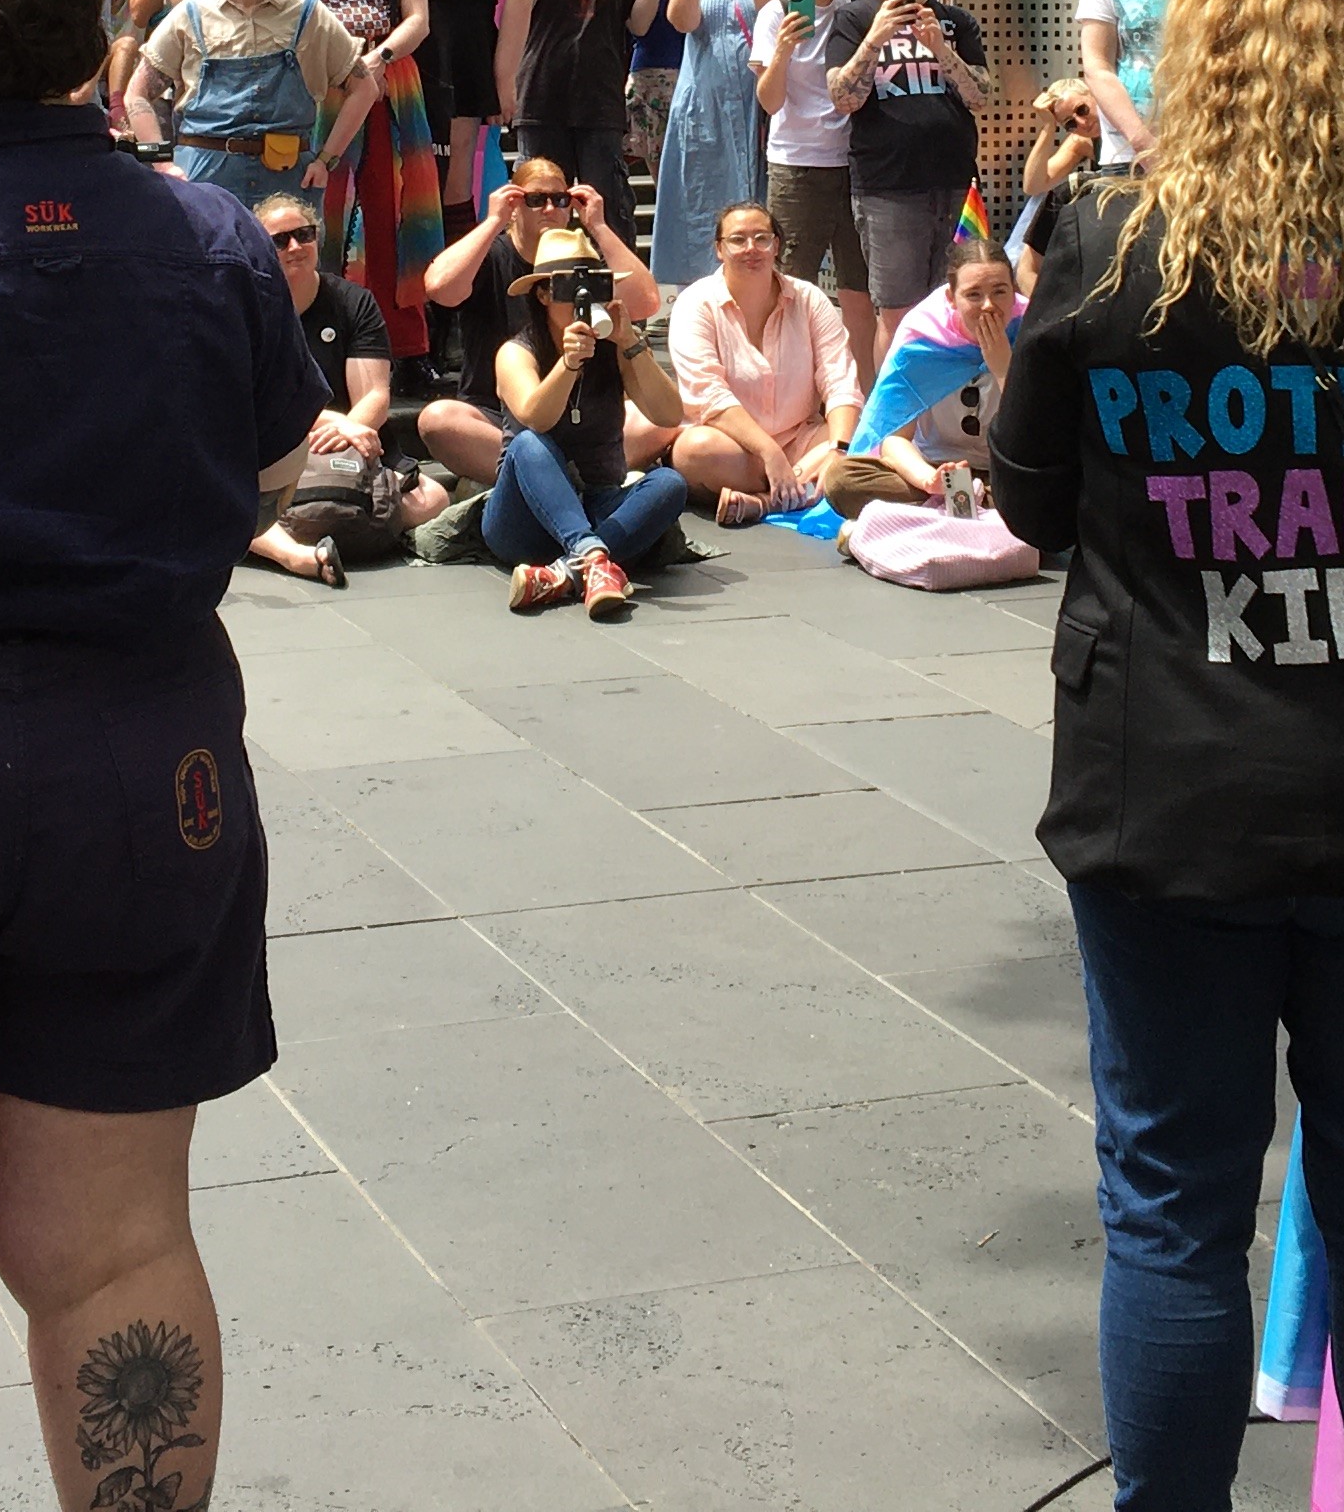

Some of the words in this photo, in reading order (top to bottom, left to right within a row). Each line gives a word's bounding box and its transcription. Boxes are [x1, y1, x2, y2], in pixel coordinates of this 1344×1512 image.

[874, 62, 947, 100] KID
[24, 201, 74, 223] SÜK
[25, 223, 79, 233] WORKWEAR
